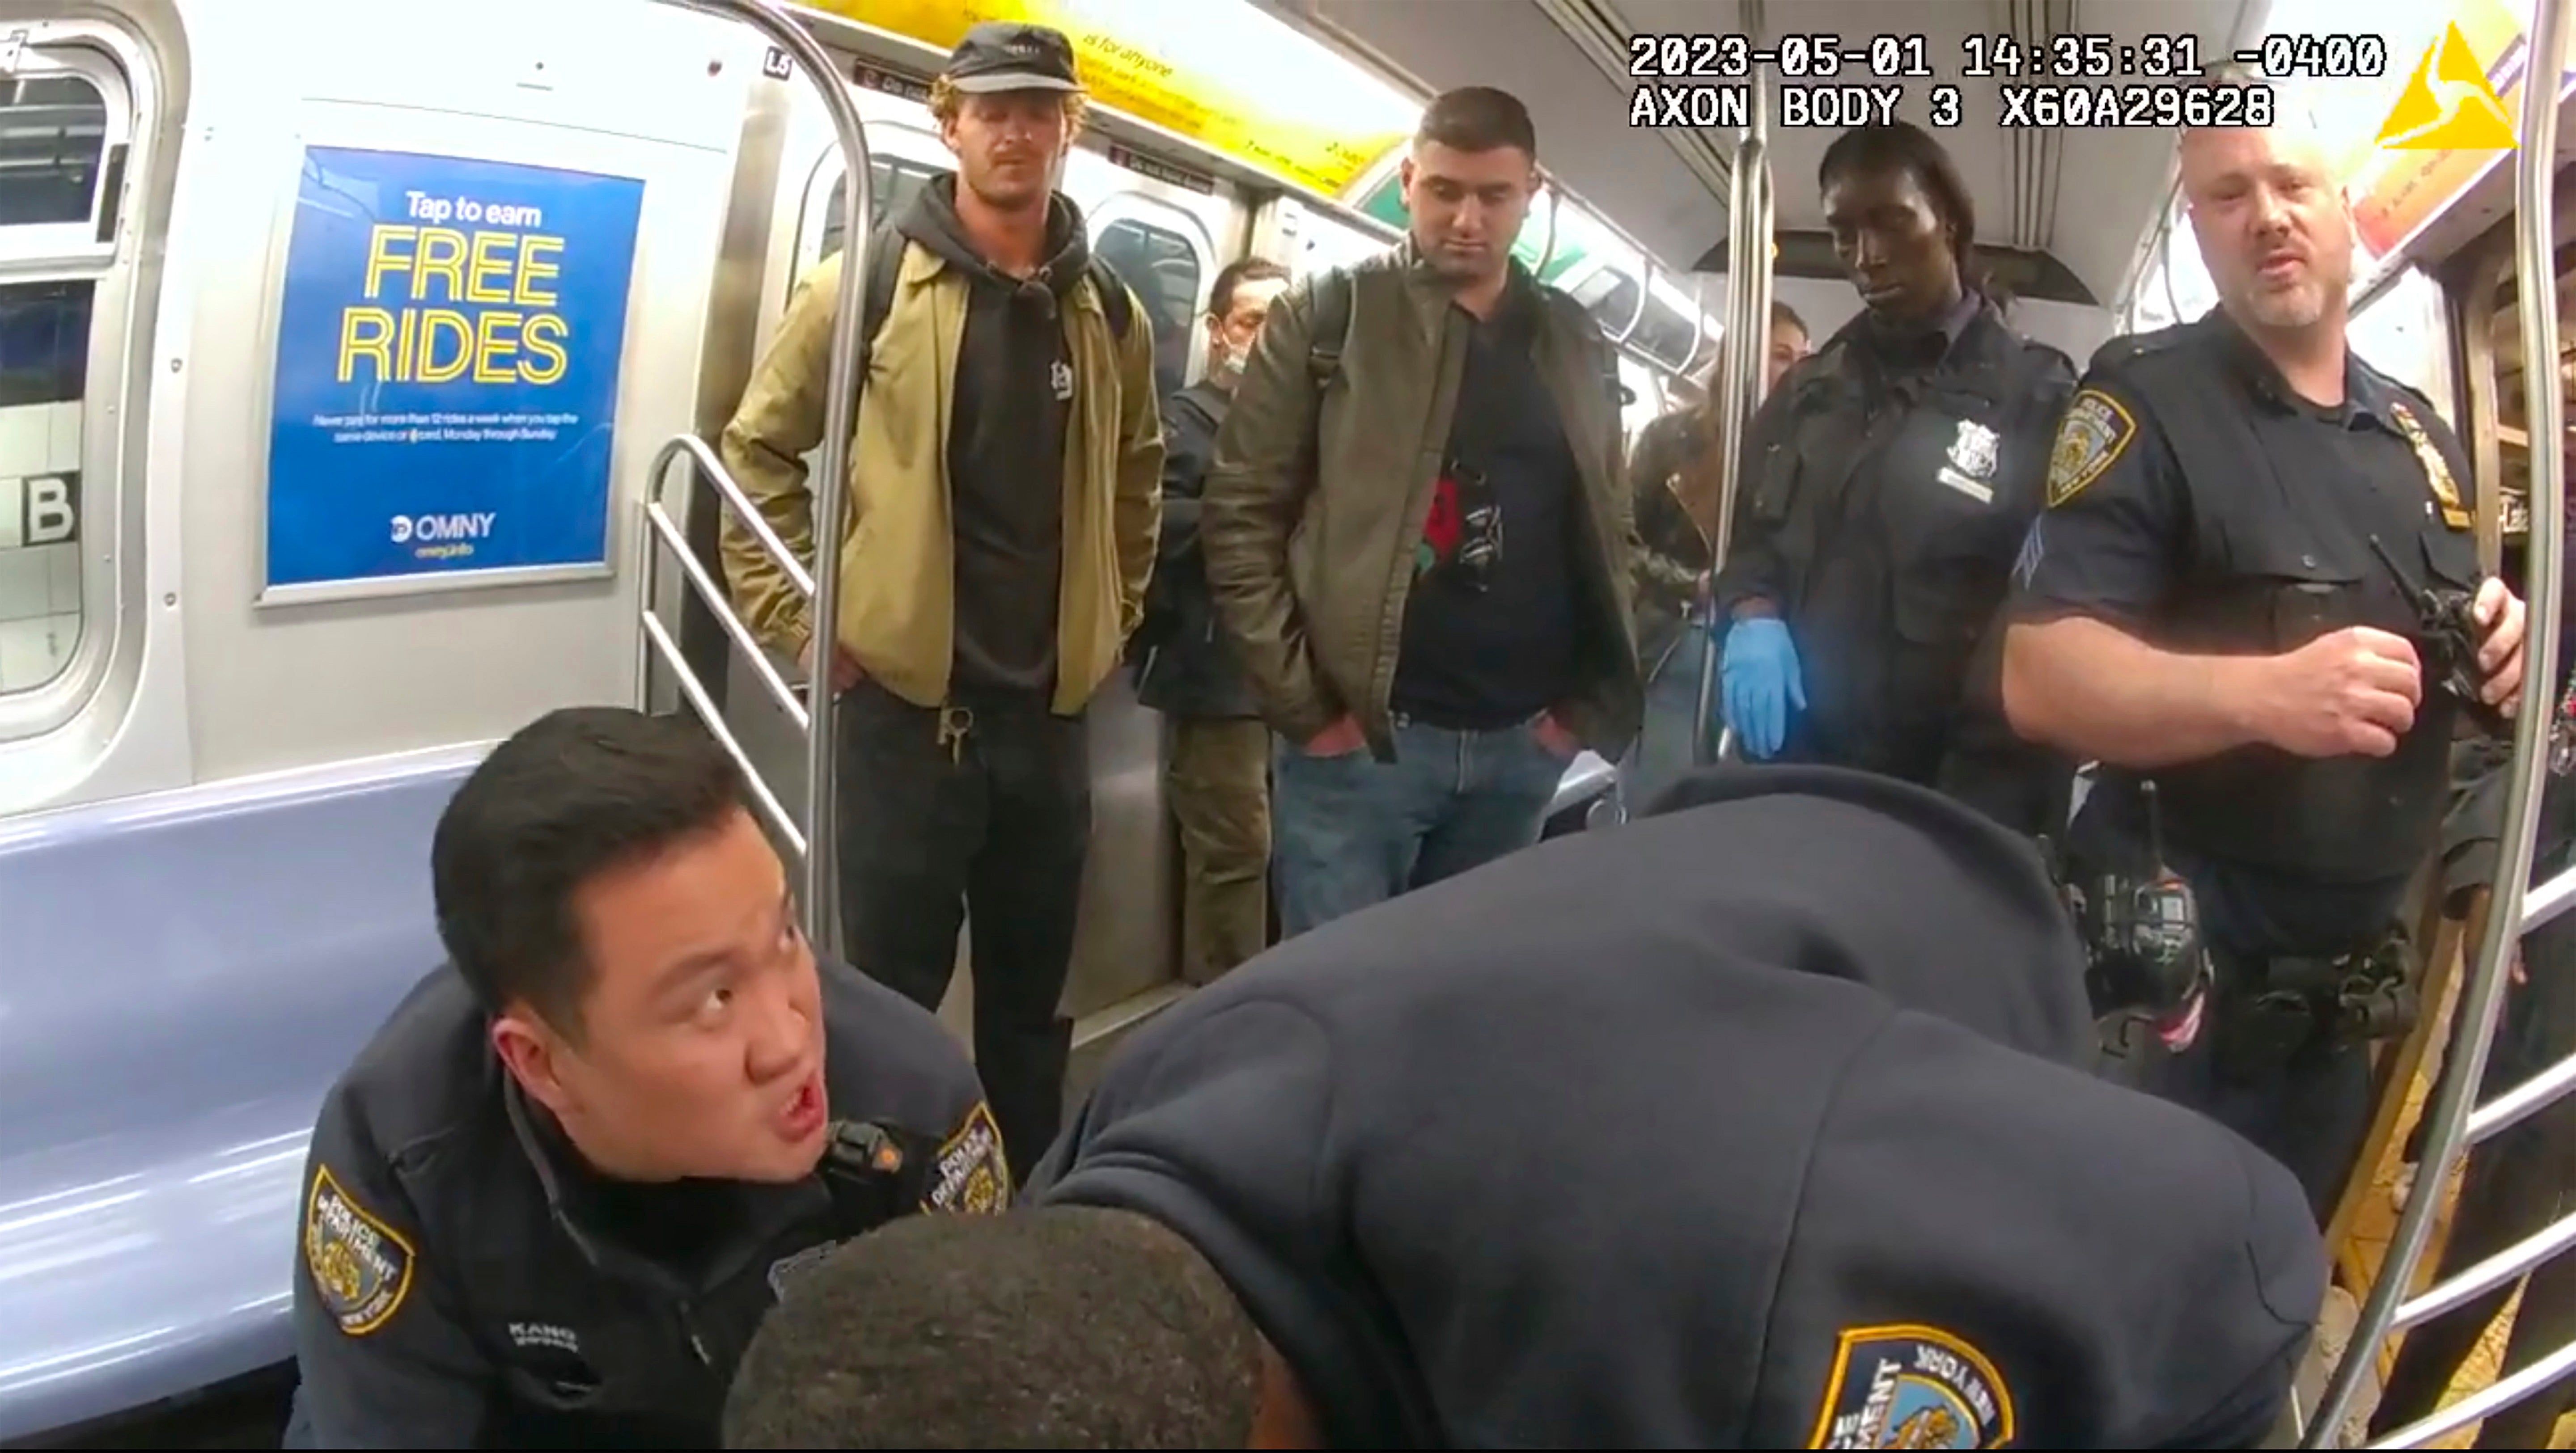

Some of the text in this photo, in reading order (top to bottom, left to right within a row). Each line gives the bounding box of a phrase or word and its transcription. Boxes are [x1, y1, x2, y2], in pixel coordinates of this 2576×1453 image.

[406, 191, 541, 227] Tap to earn
[364, 224, 565, 306] FREE
[337, 307, 568, 384] RIDES
[28, 477, 74, 542] B
[416, 512, 496, 541] OMNY
[1914, 1344, 1968, 1391] YORK
